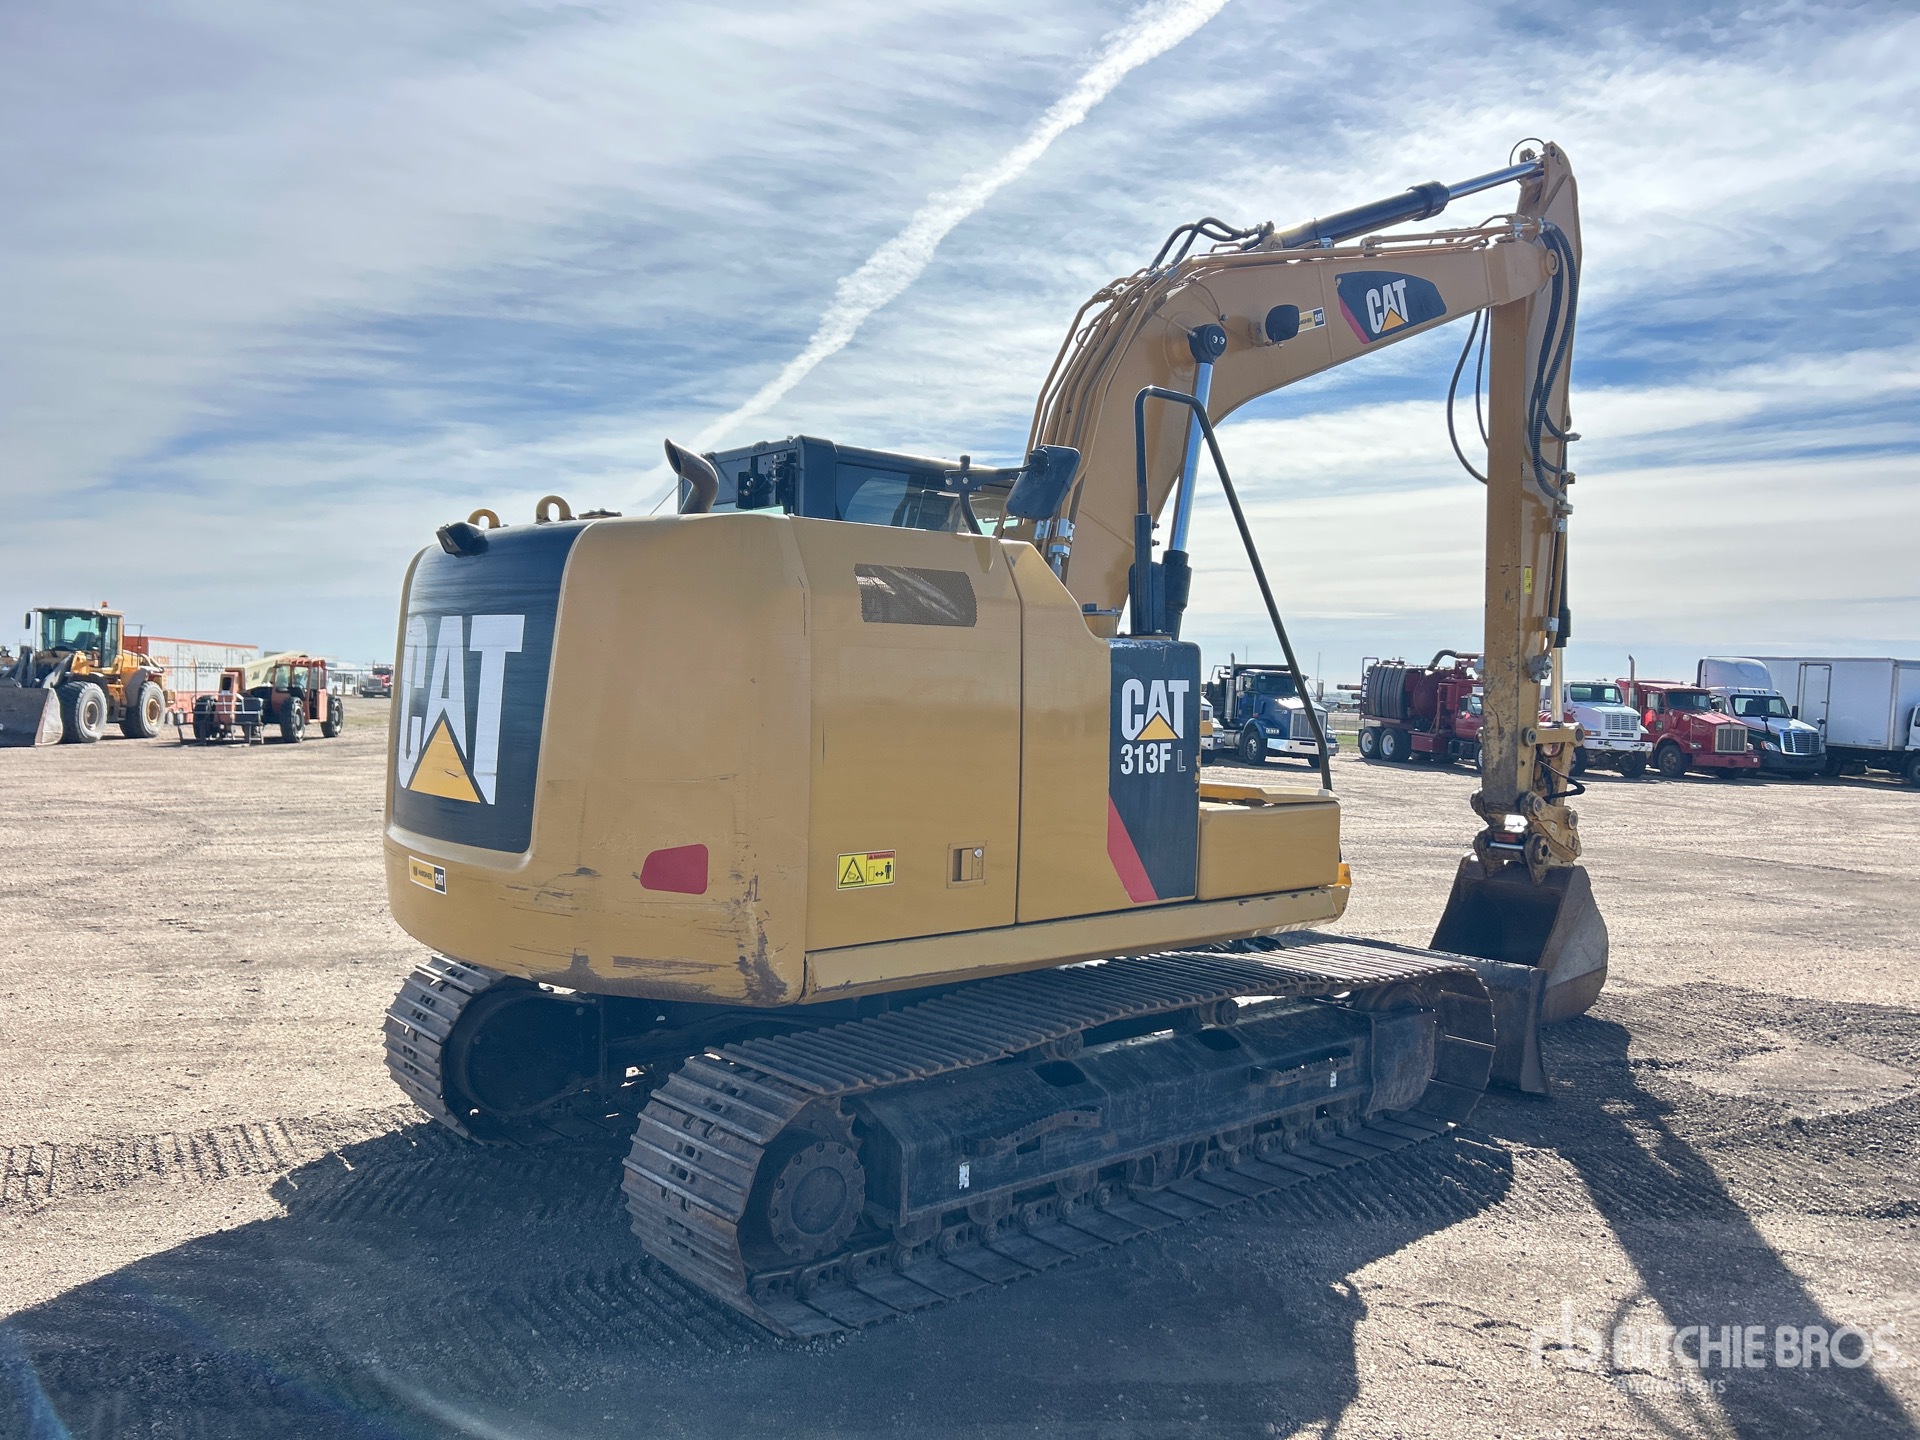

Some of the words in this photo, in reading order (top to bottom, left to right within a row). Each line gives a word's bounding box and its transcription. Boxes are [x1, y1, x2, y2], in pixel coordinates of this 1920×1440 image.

[1314, 313, 1323, 323] CAT
[1366, 278, 1409, 334] CAT
[399, 614, 525, 805] CAT
[1121, 678, 1189, 740] CAT
[1120, 742, 1172, 775] 313F
[1177, 749, 1187, 772] L
[435, 872, 444, 886] CAT
